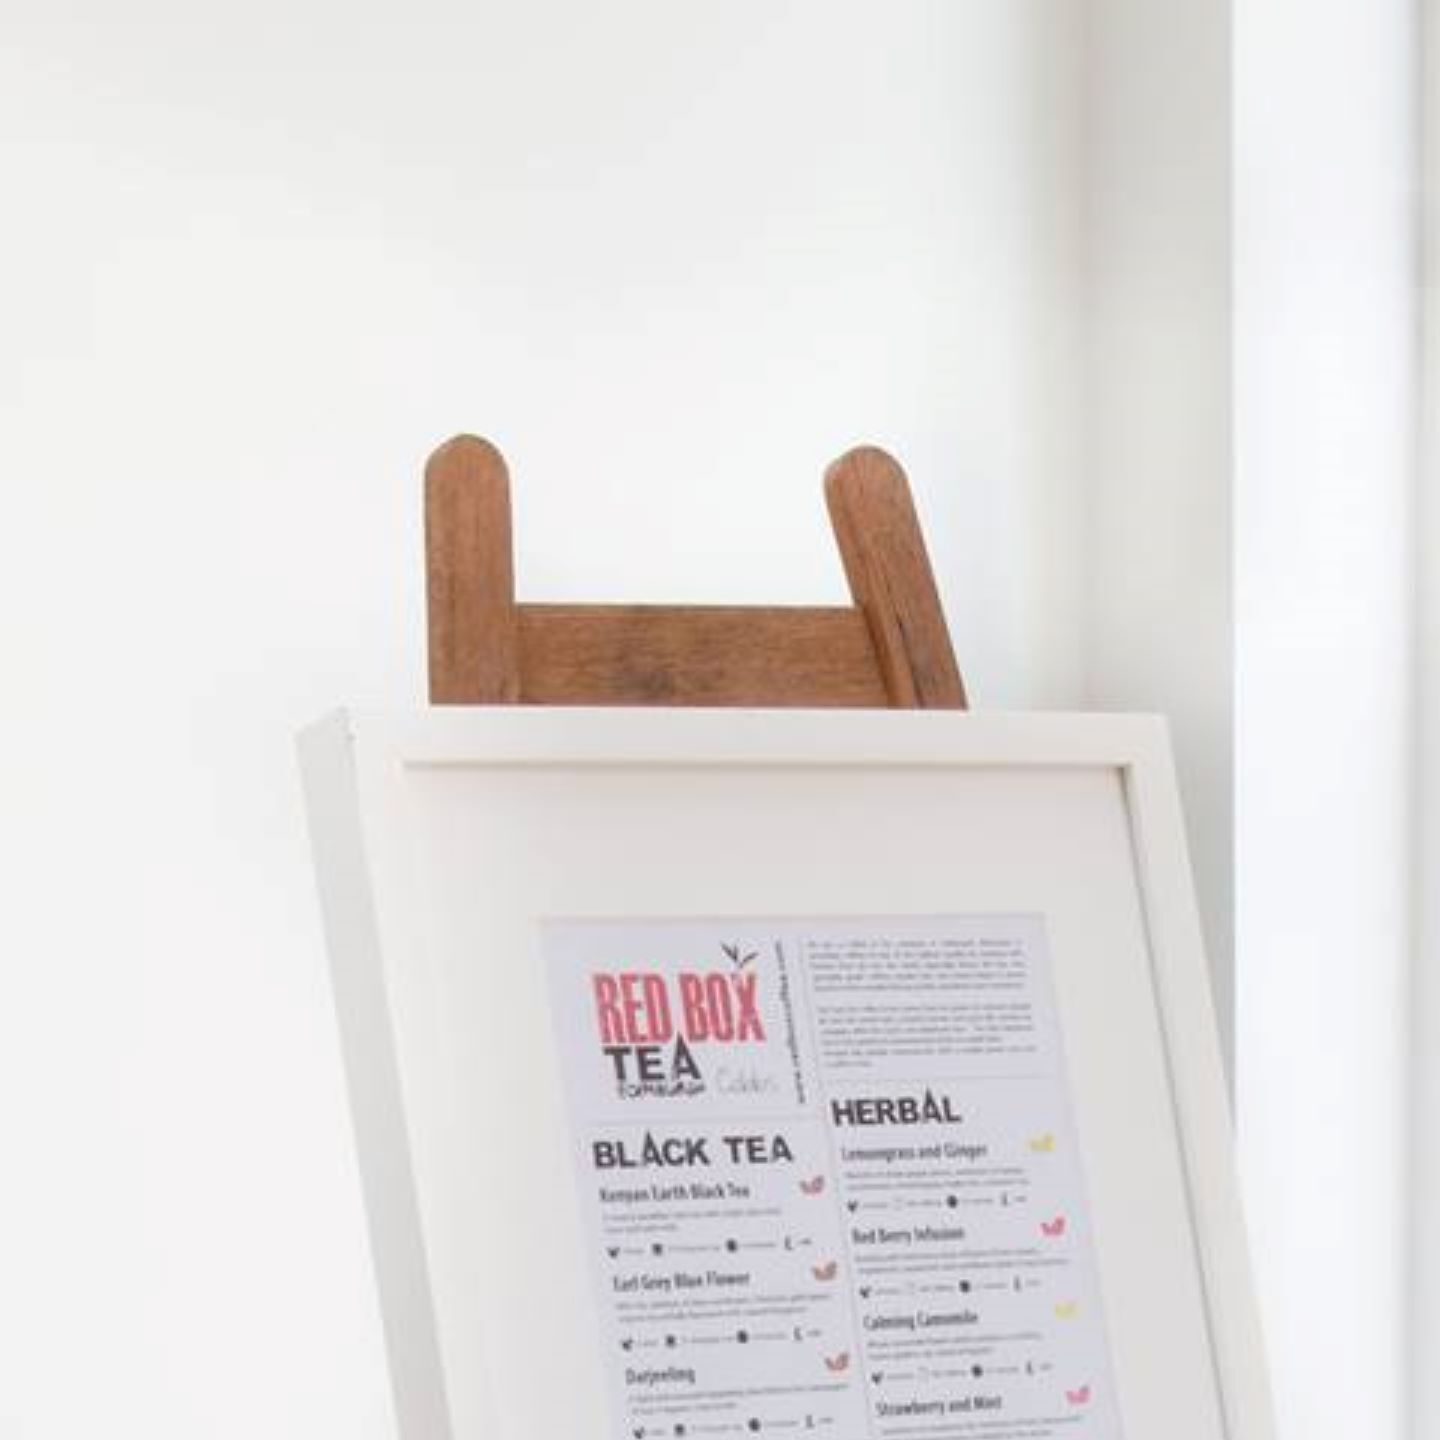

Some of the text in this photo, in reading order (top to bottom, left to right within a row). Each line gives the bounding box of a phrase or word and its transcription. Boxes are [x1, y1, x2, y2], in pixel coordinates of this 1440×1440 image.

[592, 972, 673, 1044] RED
[677, 971, 767, 1042] BOX
[603, 1031, 702, 1081] TEA
[831, 1088, 962, 1126] HERBAL
[593, 1131, 793, 1169] BLACK TEA
[919, 1144, 941, 1159] and
[944, 1142, 988, 1162] Ginger
[691, 1183, 725, 1199] Black
[727, 1182, 750, 1198] Tea
[852, 1227, 876, 1244] Red
[613, 1274, 638, 1291] Earl
[625, 1367, 696, 1386] Darjeeling
[876, 1398, 945, 1417] Strawberry
[949, 1395, 971, 1412] and
